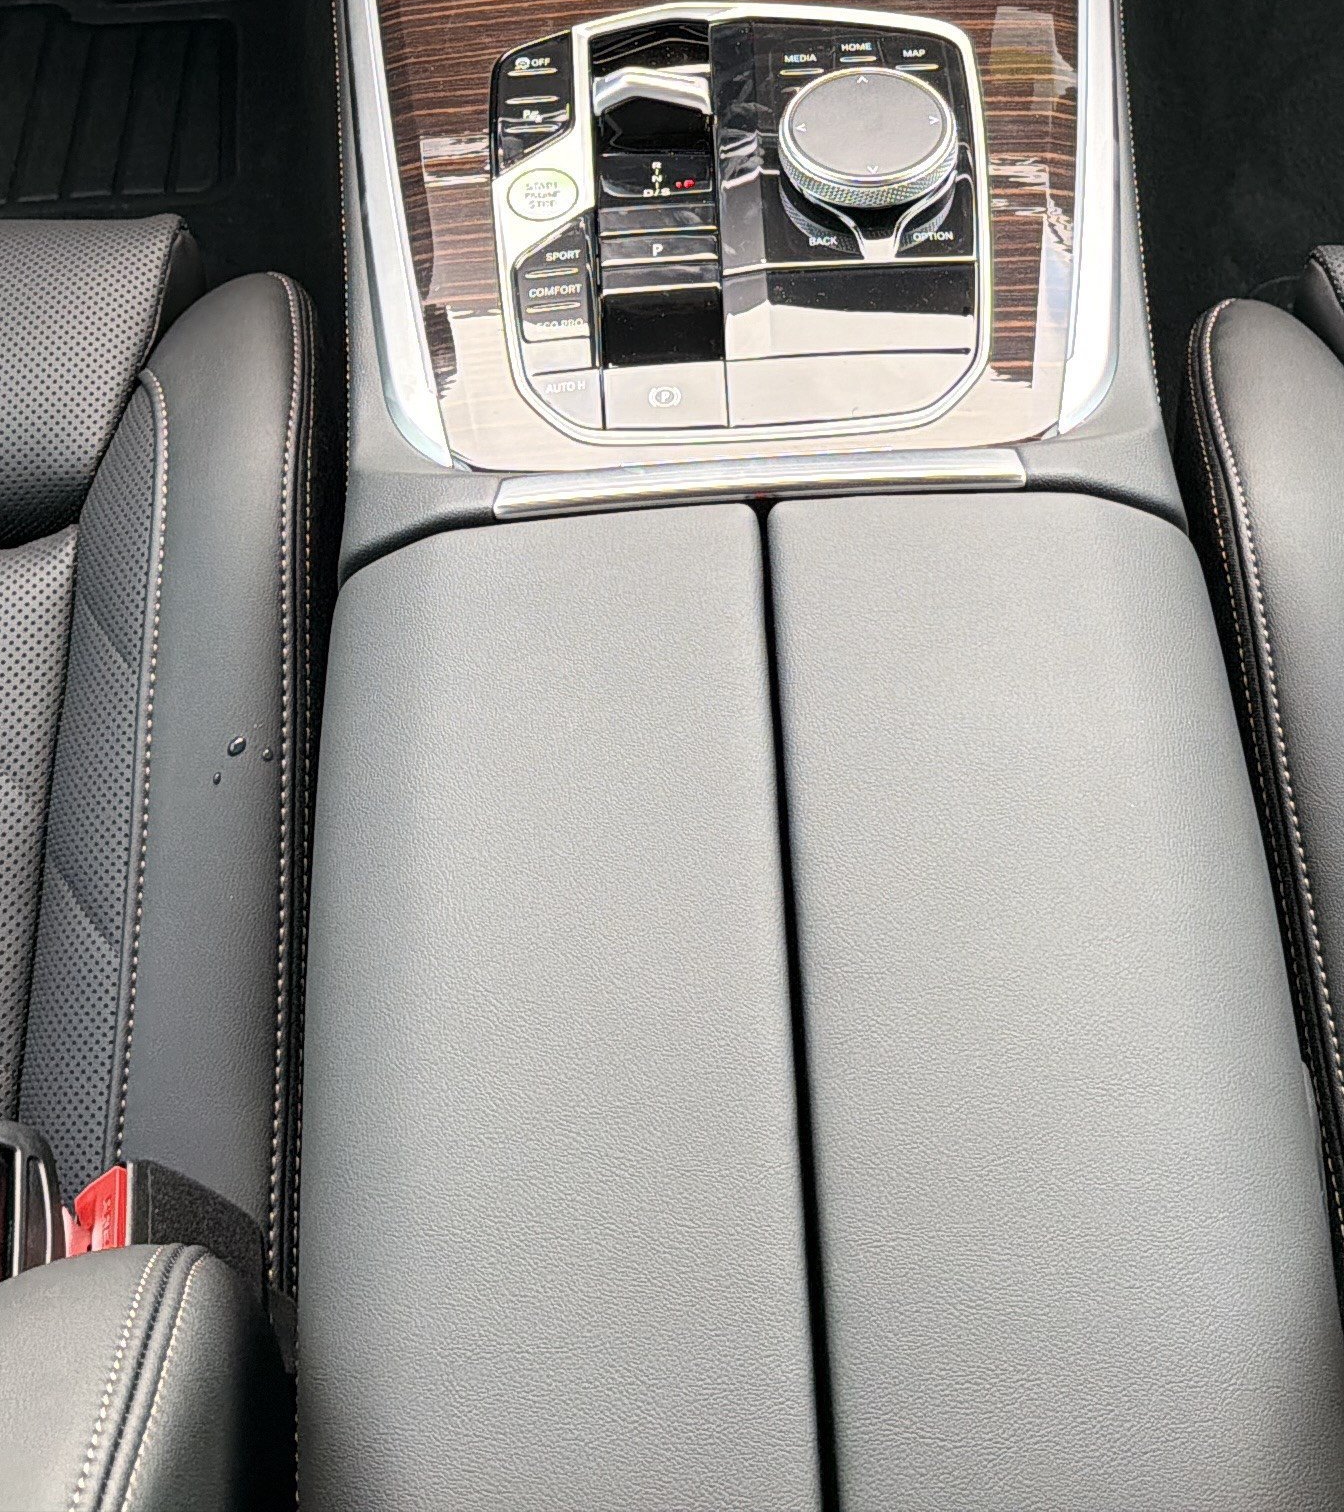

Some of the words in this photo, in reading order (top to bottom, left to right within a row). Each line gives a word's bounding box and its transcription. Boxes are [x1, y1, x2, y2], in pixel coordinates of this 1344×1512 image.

[841, 42, 872, 52] HOME
[784, 54, 817, 63] MEDIA
[902, 49, 926, 58] MAP
[531, 57, 551, 67] OFF
[809, 236, 838, 246] BACK
[912, 231, 954, 241] OPTION
[652, 243, 664, 257] P
[545, 249, 581, 263] SPORT
[528, 284, 582, 298] COMFORT
[545, 381, 575, 394] AUTO
[577, 381, 586, 390] H
